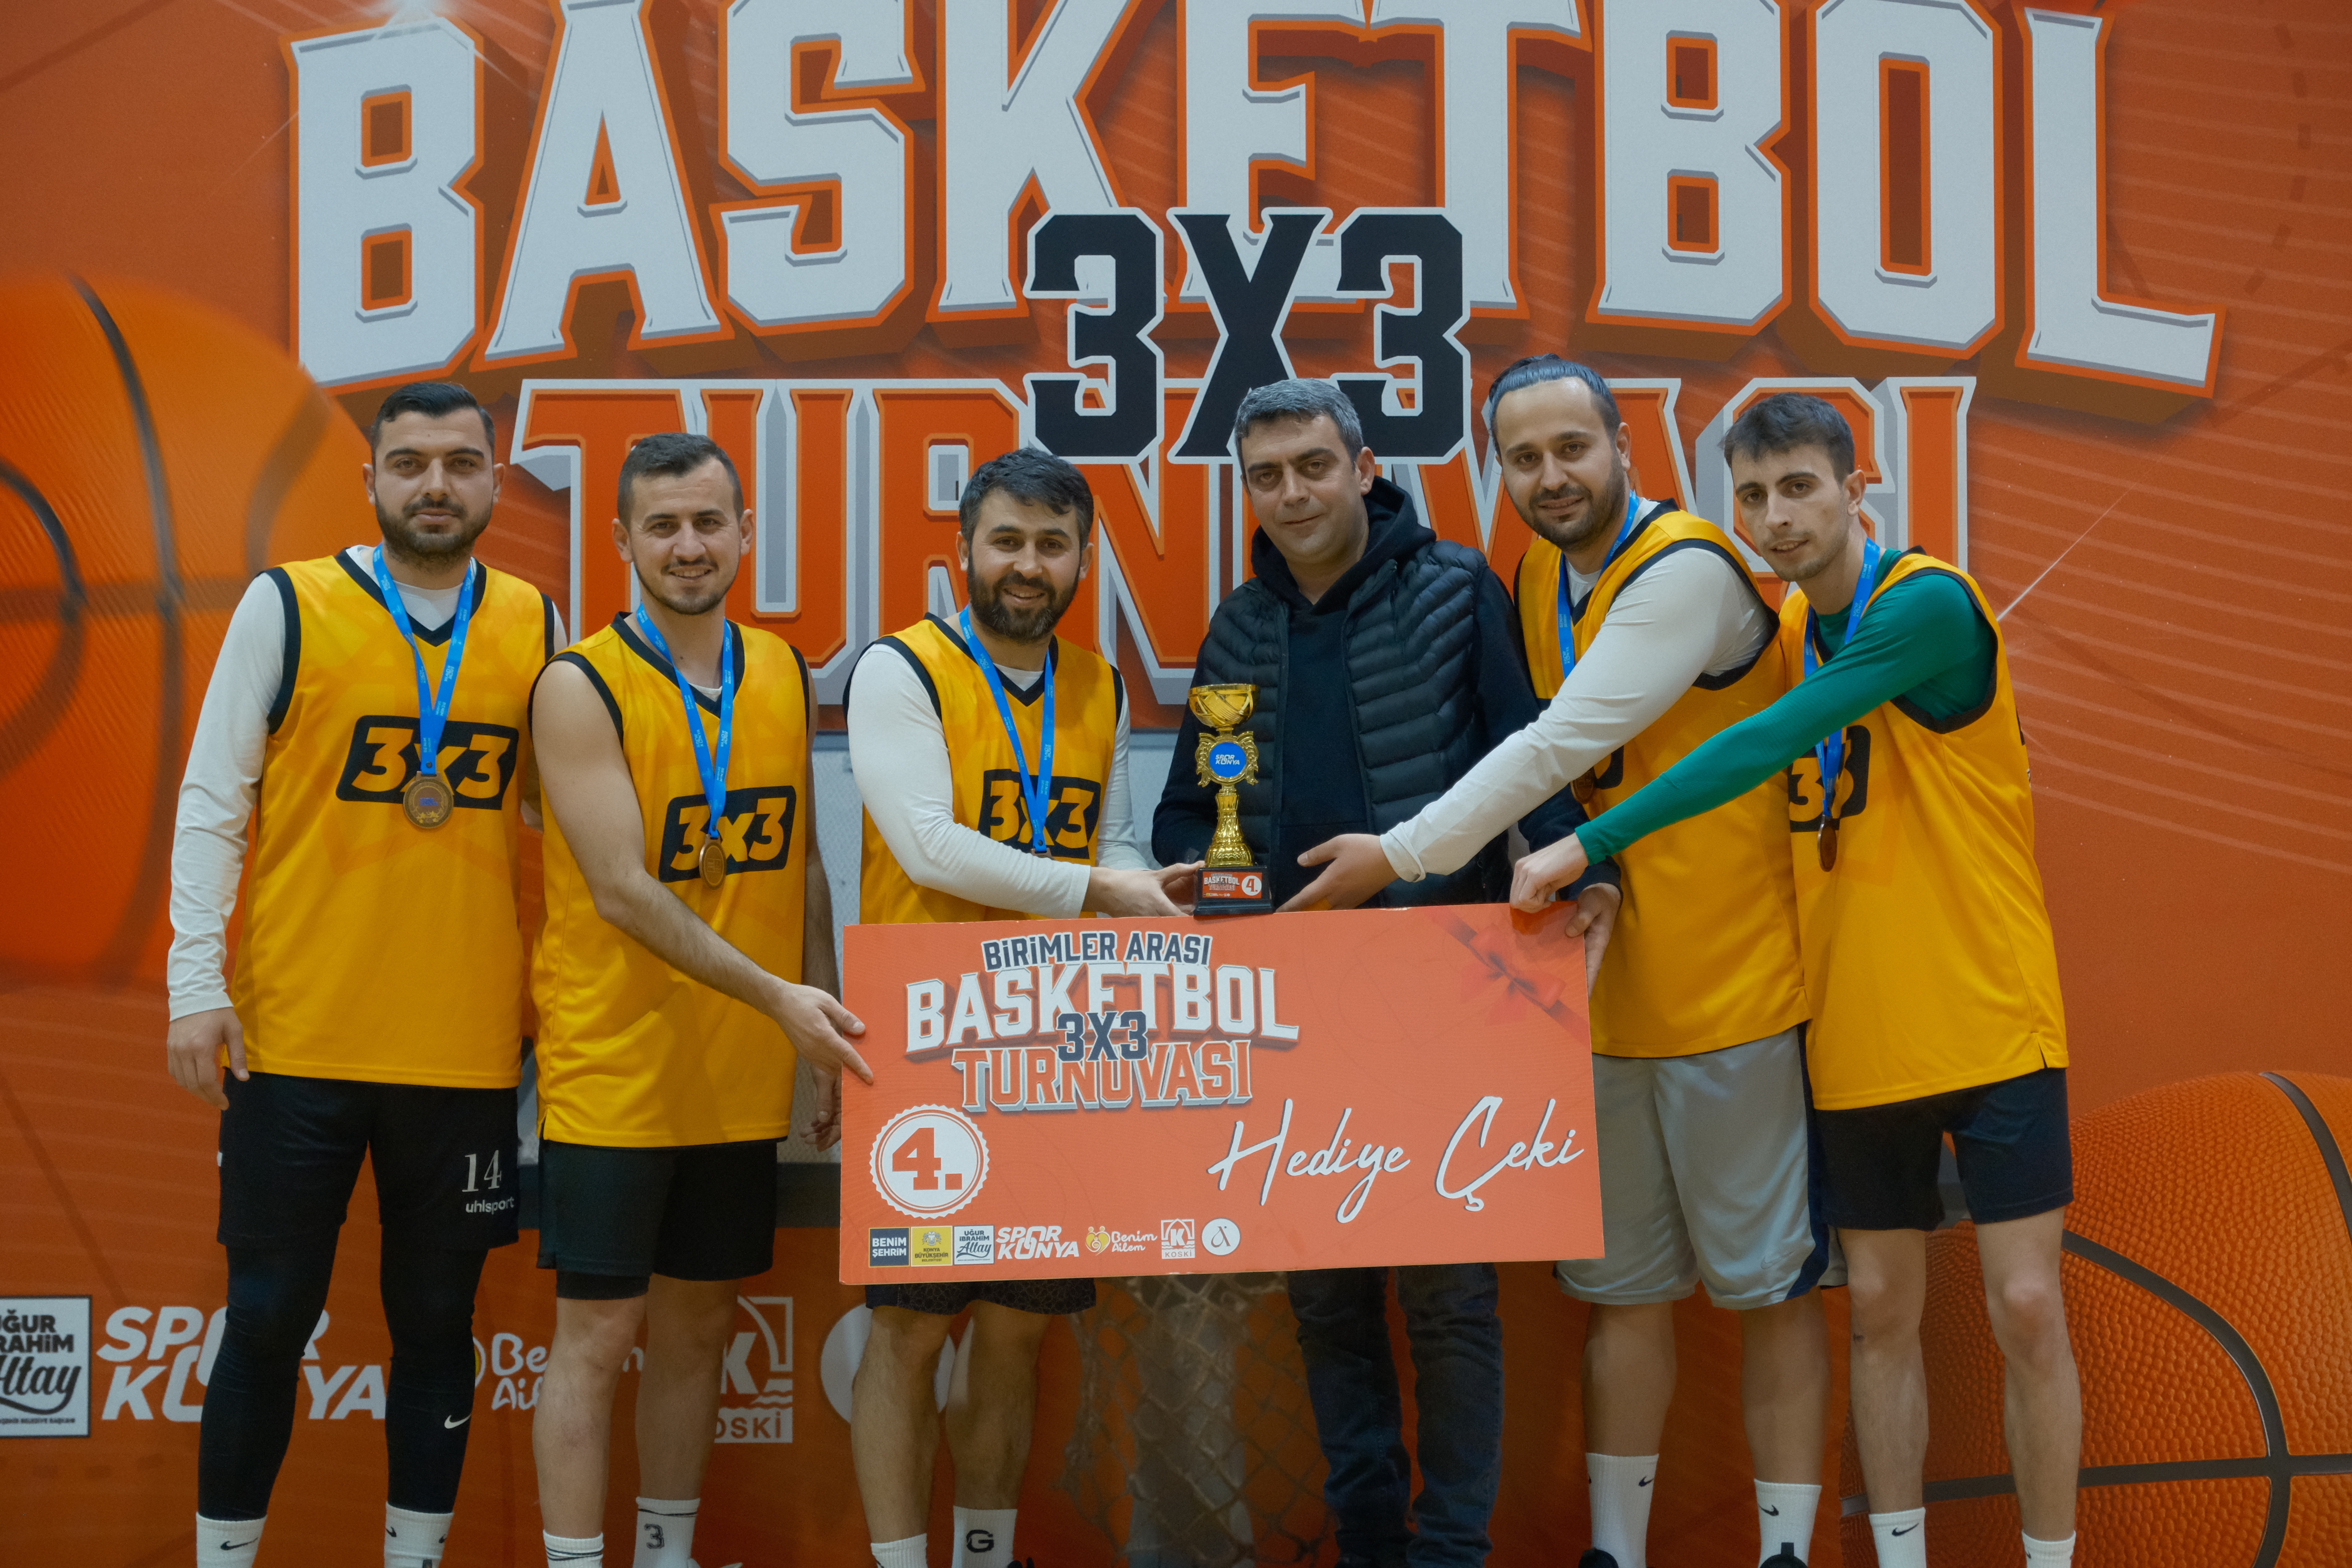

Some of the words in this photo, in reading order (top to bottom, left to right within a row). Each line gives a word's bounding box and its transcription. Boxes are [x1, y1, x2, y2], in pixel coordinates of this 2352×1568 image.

[288, 0, 2217, 385] BASKETBOL
[1029, 212, 1464, 458] 3X3
[1204, 877, 1240, 885] BASKETBOL
[1246, 878, 1258, 892] 4.
[983, 933, 1117, 971] BİRİMLER
[1126, 932, 1212, 966] ARASI
[906, 961, 1299, 1053] BASKETBOL
[1057, 1010, 1148, 1062] 3X3
[952, 1040, 1252, 1110] TURNUVASI
[892, 1127, 962, 1190] 4.
[1207, 1098, 1410, 1223] Hediye
[1435, 1096, 1584, 1211] Çeki
[461, 1150, 502, 1192] 14
[466, 1196, 514, 1215] uhlsport
[872, 1237, 907, 1247] BENİM
[996, 1226, 1062, 1245] SPOR
[1111, 1230, 1158, 1243] Benim
[1111, 1243, 1146, 1252] Ailem
[872, 1247, 907, 1258] ŞEHRİM
[956, 1242, 992, 1258] Altay
[997, 1237, 1080, 1260] KONYA
[1165, 1249, 1192, 1258] KOSKİ
[0, 1309, 56, 1333] ĞUR
[716, 1411, 781, 1439] OSKİ
[644, 1524, 665, 1550] 3
[966, 1529, 994, 1553] G
